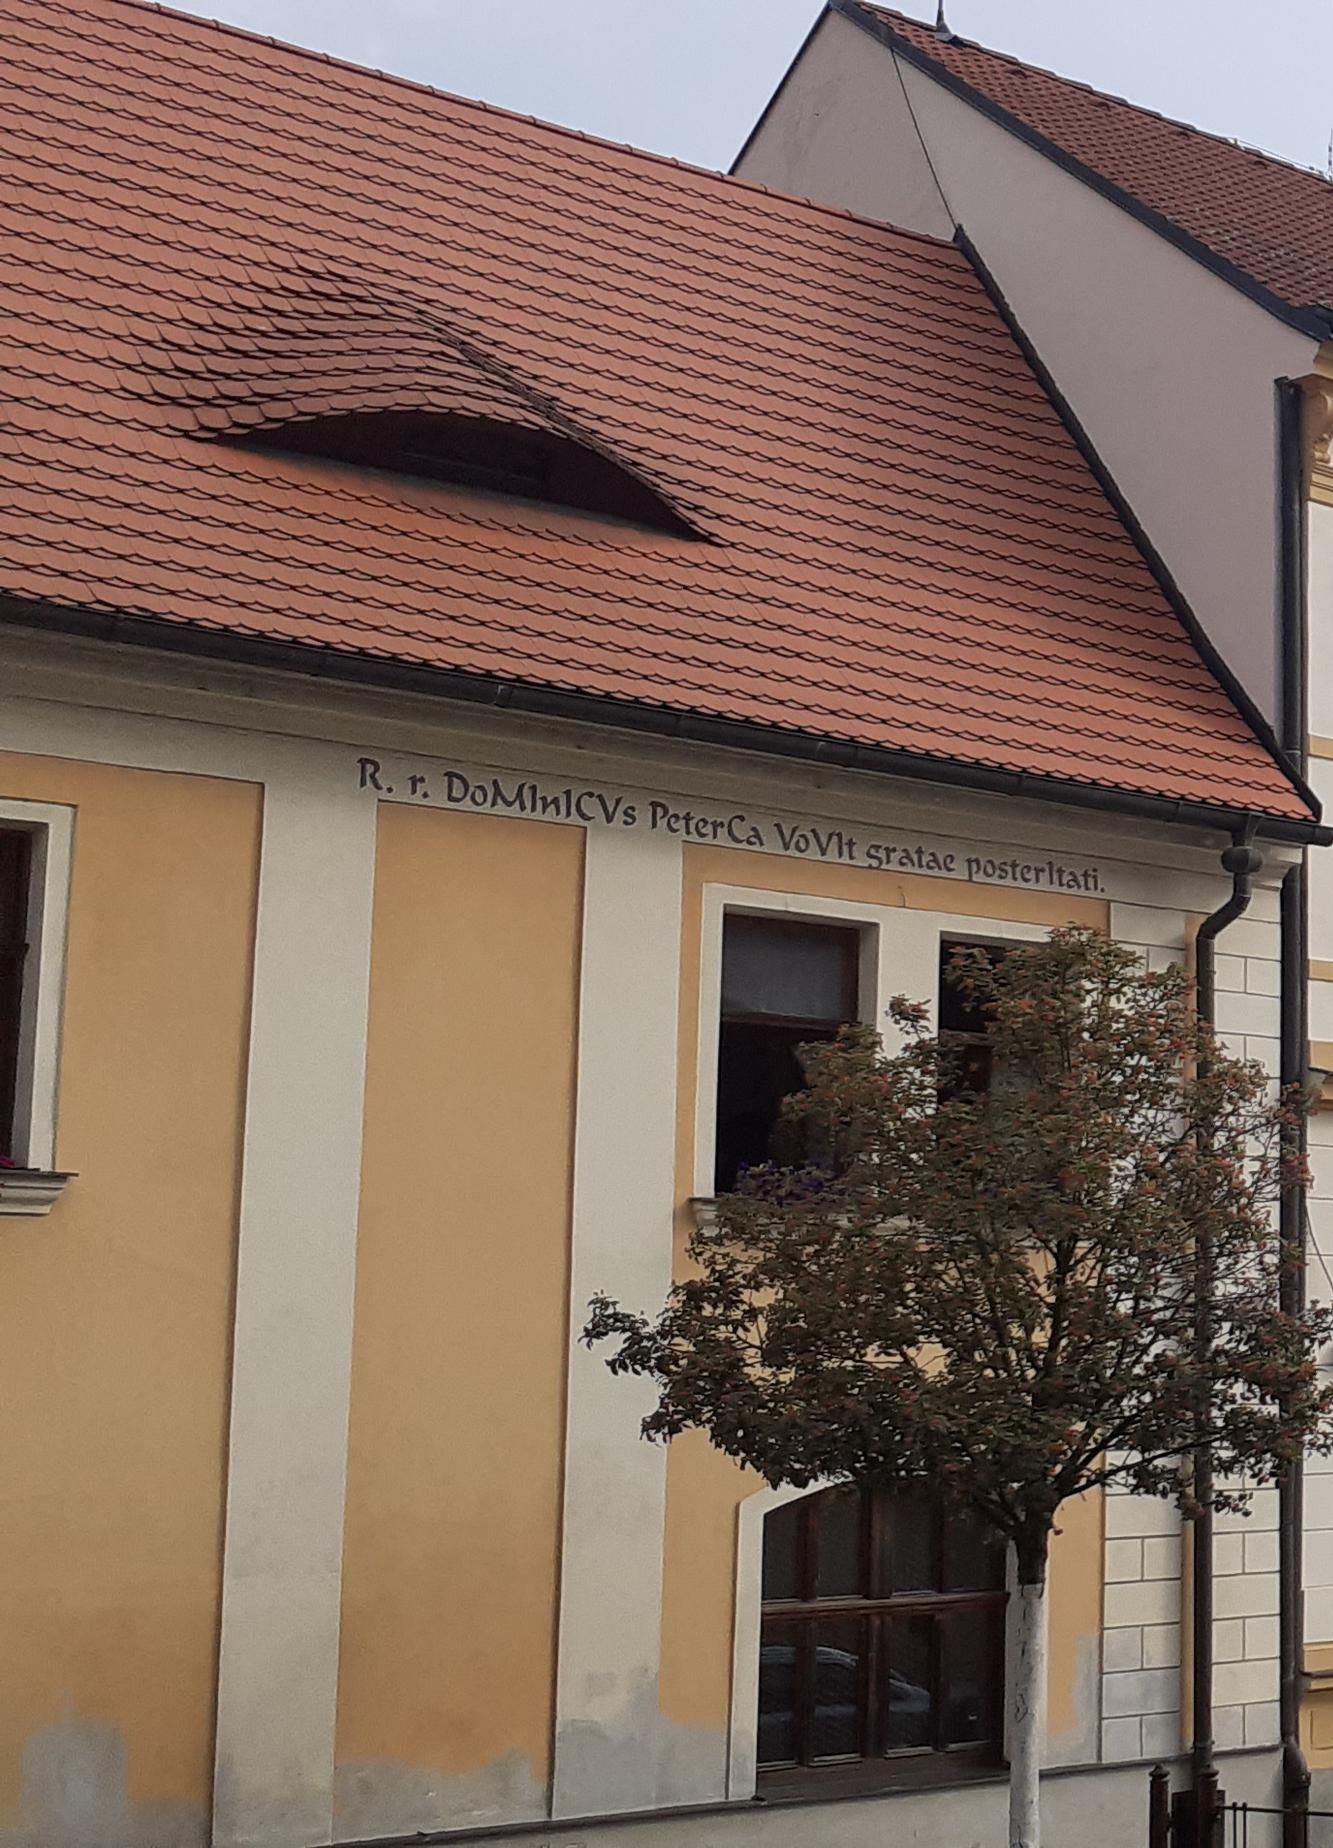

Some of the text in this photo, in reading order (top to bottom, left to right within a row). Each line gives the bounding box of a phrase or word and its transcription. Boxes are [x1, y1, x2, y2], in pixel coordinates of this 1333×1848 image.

[356, 757, 394, 793] R.
[408, 774, 429, 799] r.
[865, 842, 956, 870] gratae
